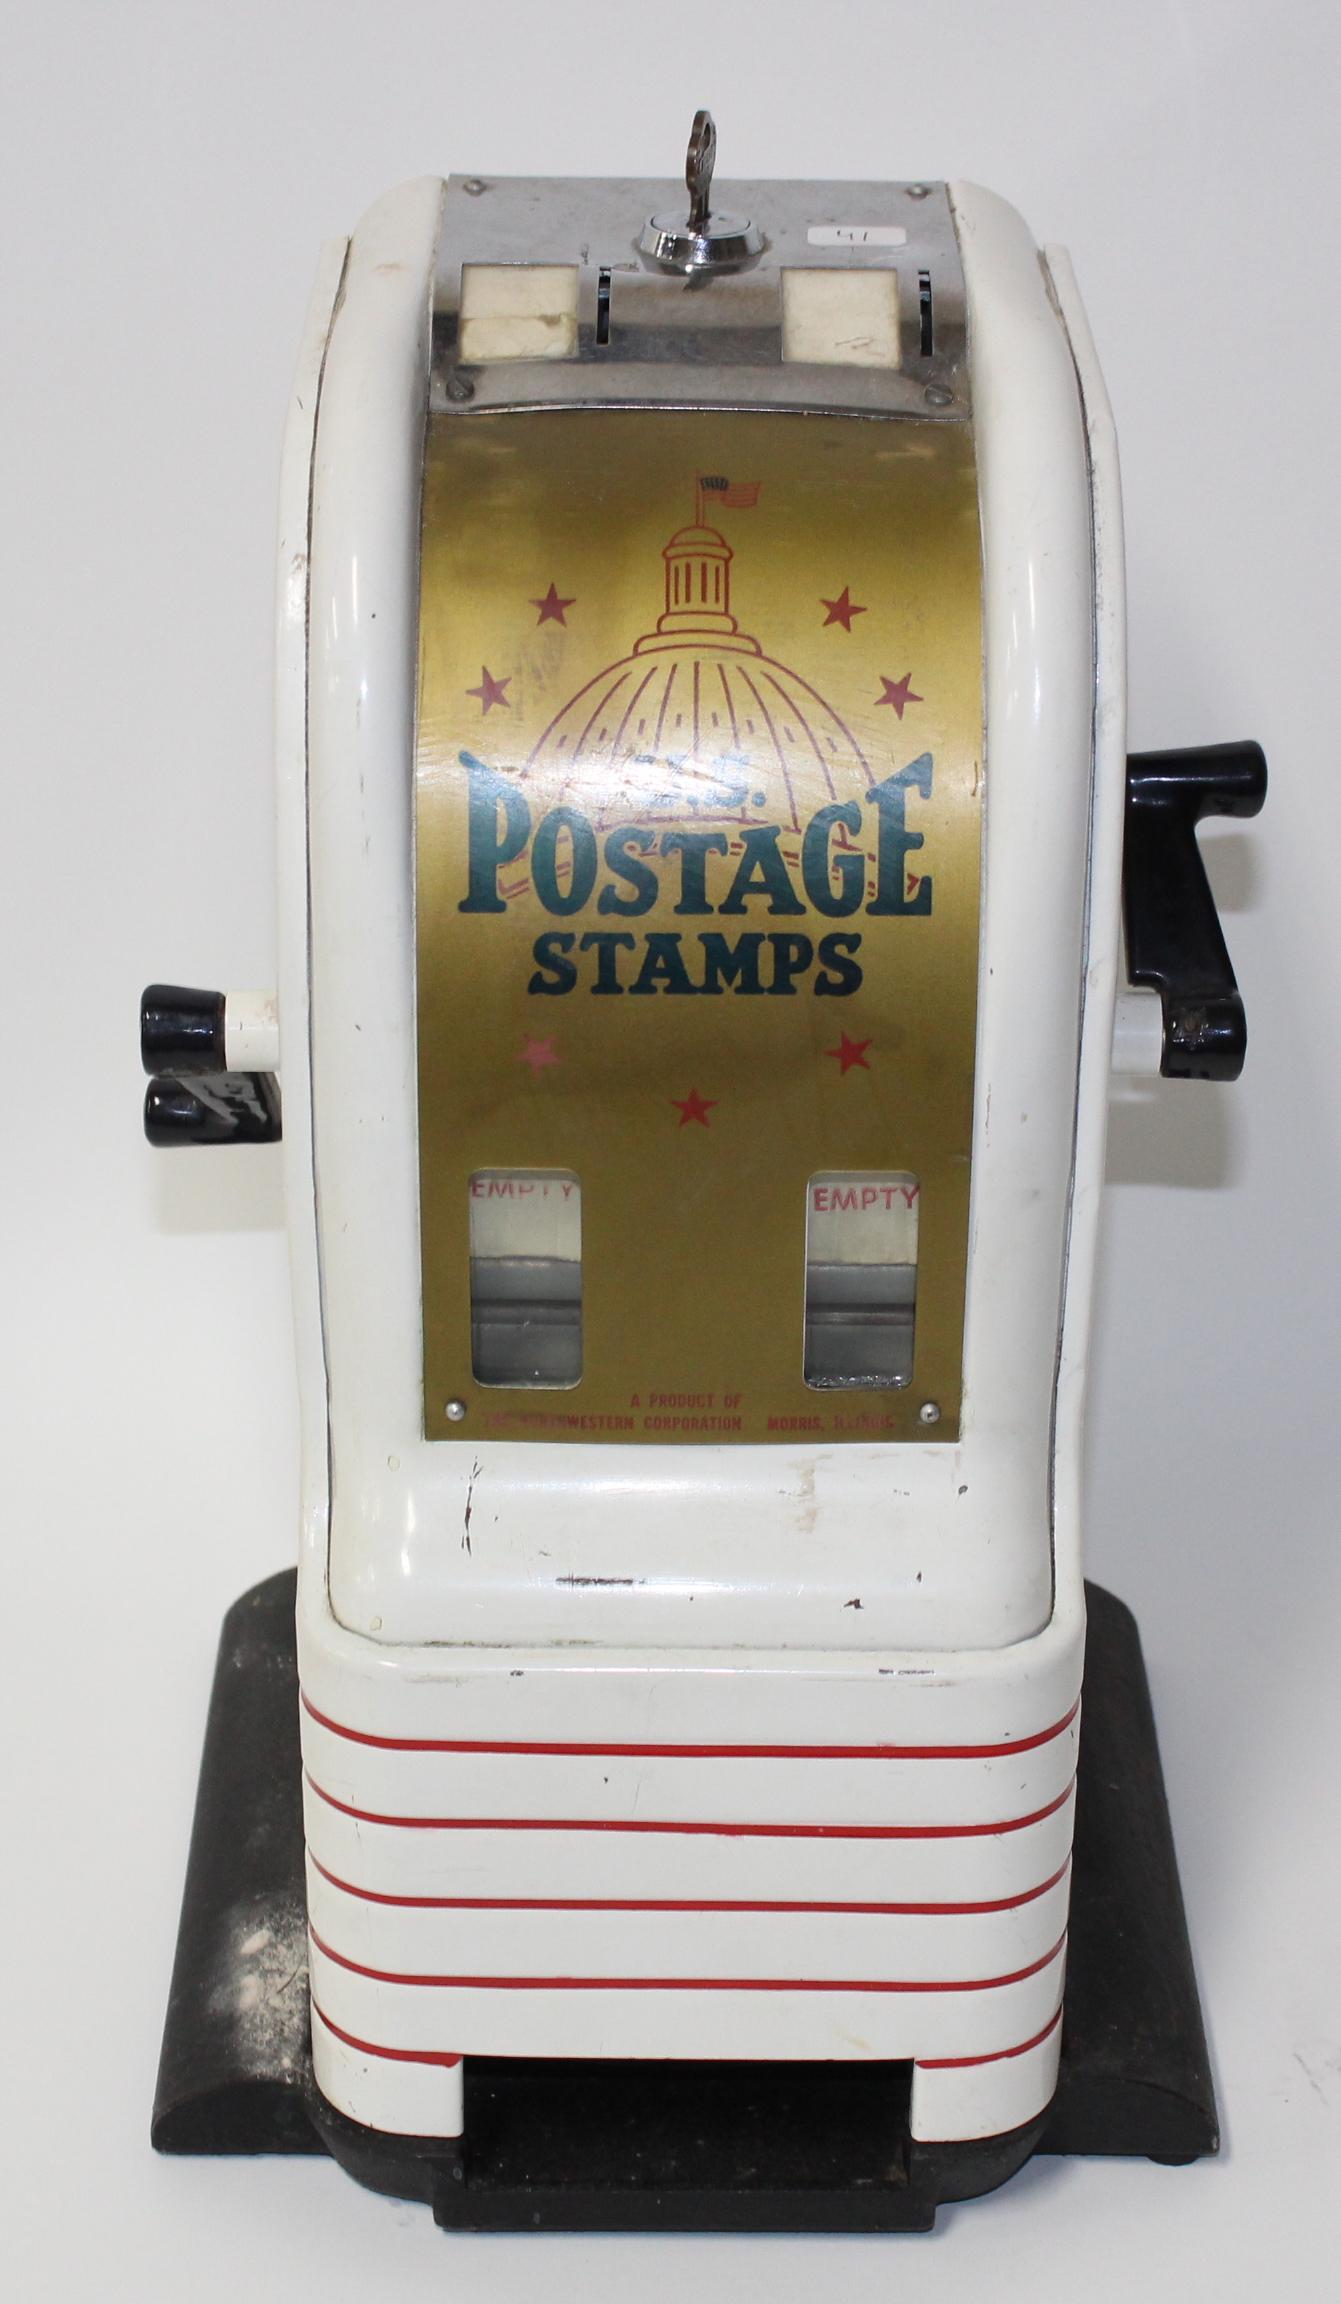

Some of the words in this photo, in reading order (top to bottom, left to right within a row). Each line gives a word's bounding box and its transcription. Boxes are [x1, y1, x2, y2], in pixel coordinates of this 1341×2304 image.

[457, 750, 934, 917] POSTAGE
[528, 931, 864, 996] STAMPS
[813, 1183, 920, 1211] EMPTY
[630, 1393, 641, 1408] A
[649, 1393, 715, 1408] PRODUCT
[724, 1393, 743, 1408] OF
[644, 1415, 743, 1431] CORPORATION
[767, 1415, 825, 1432] MORRIS,
